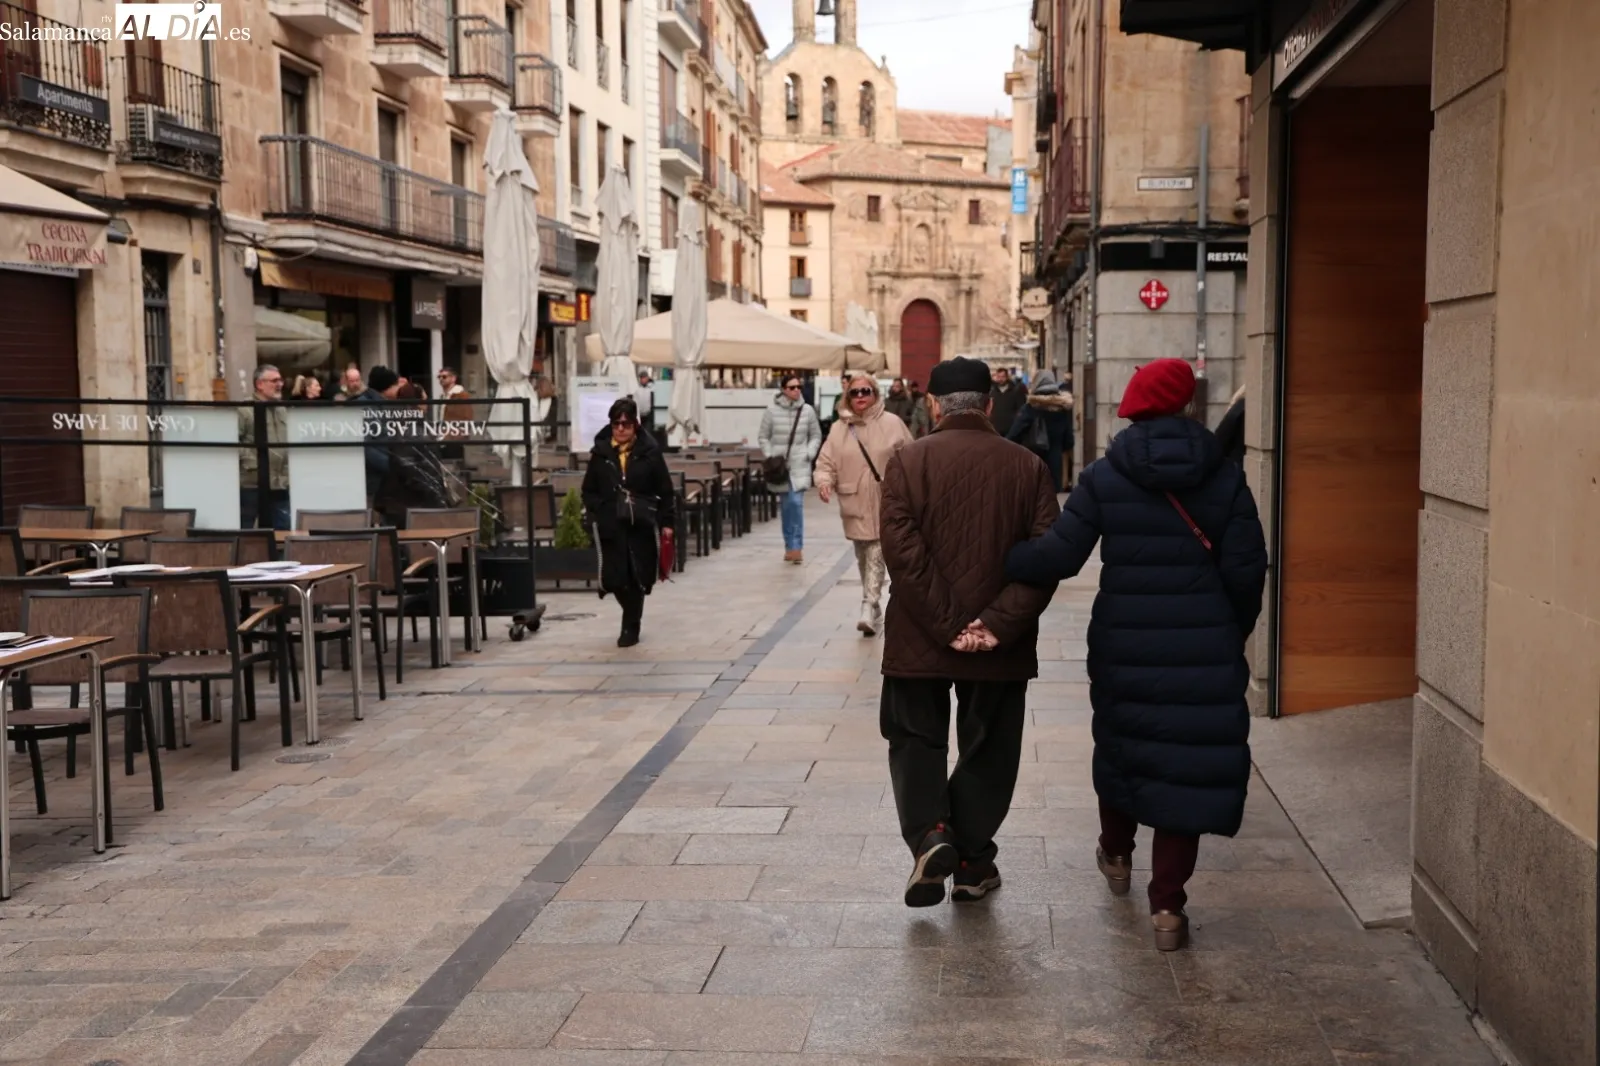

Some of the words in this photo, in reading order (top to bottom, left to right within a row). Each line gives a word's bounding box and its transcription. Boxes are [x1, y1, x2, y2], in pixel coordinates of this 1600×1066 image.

[37, 83, 94, 113] Apartments
[42, 222, 88, 244] COCINA
[52, 412, 109, 431] TAPAS
[116, 414, 138, 431] DE
[147, 414, 195, 432] CASA
[387, 420, 417, 437] LAS
